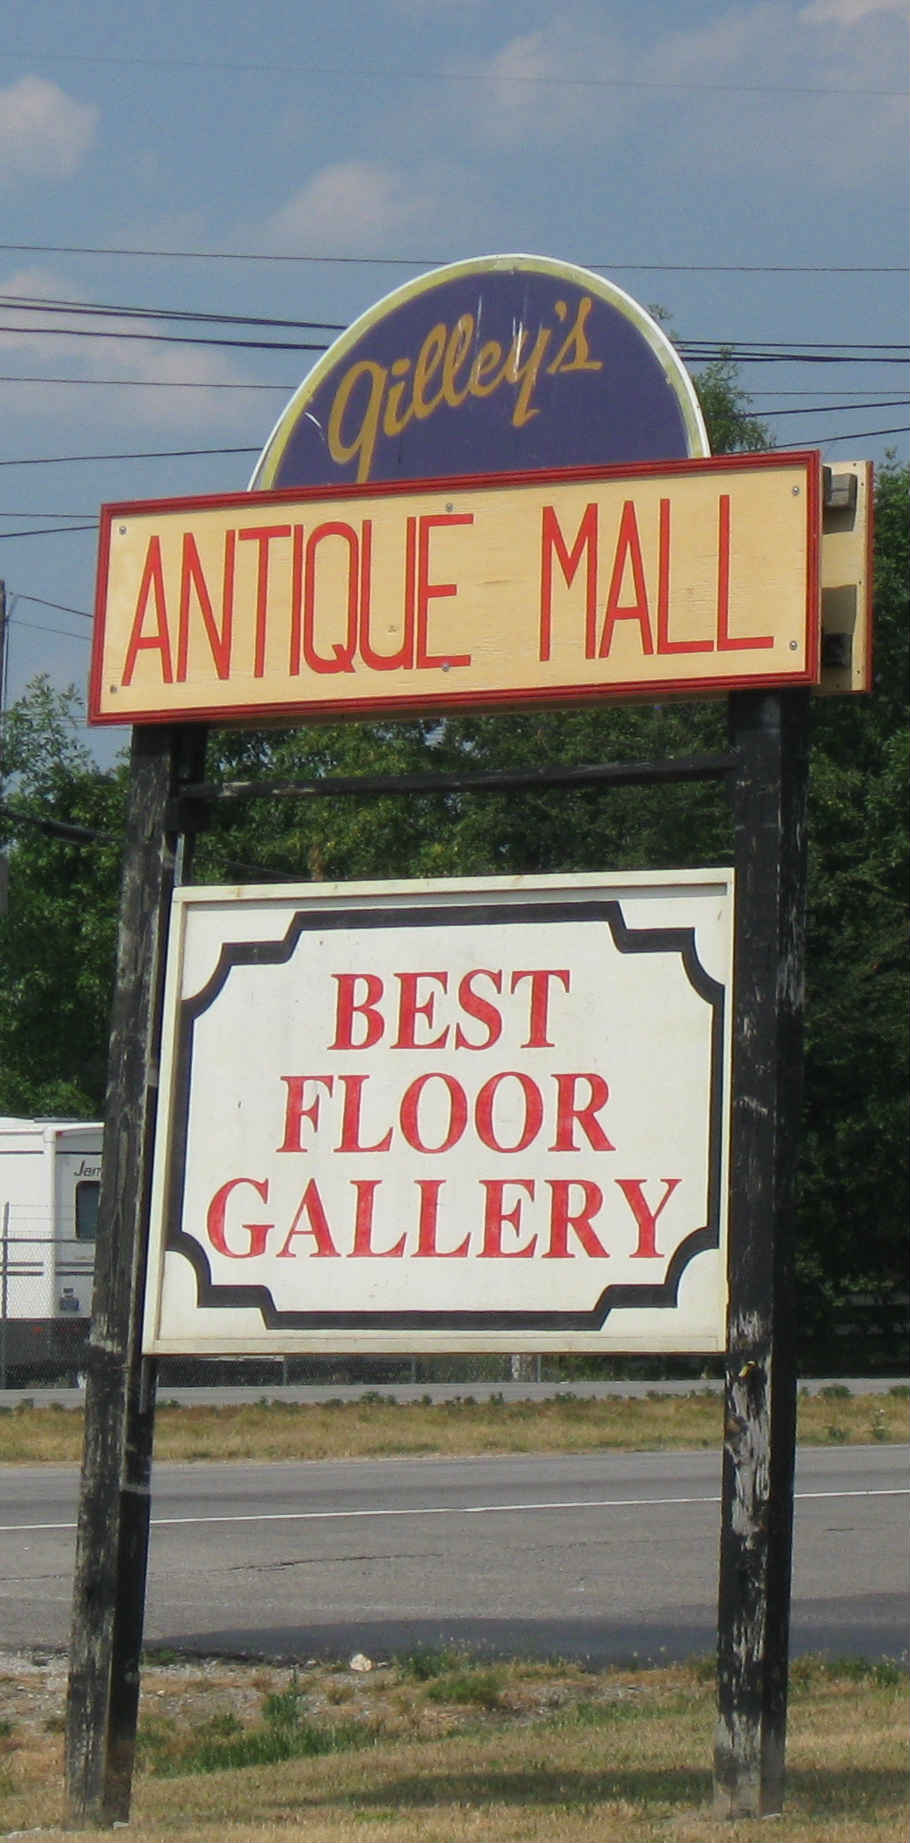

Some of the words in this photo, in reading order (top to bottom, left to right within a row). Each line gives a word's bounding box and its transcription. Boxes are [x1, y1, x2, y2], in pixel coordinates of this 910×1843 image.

[122, 513, 474, 687] ANTIQUE
[539, 495, 775, 662] MALL
[327, 969, 570, 1051] BEST
[276, 1071, 616, 1153] FLOOR
[206, 1177, 682, 1259] GALLERY
